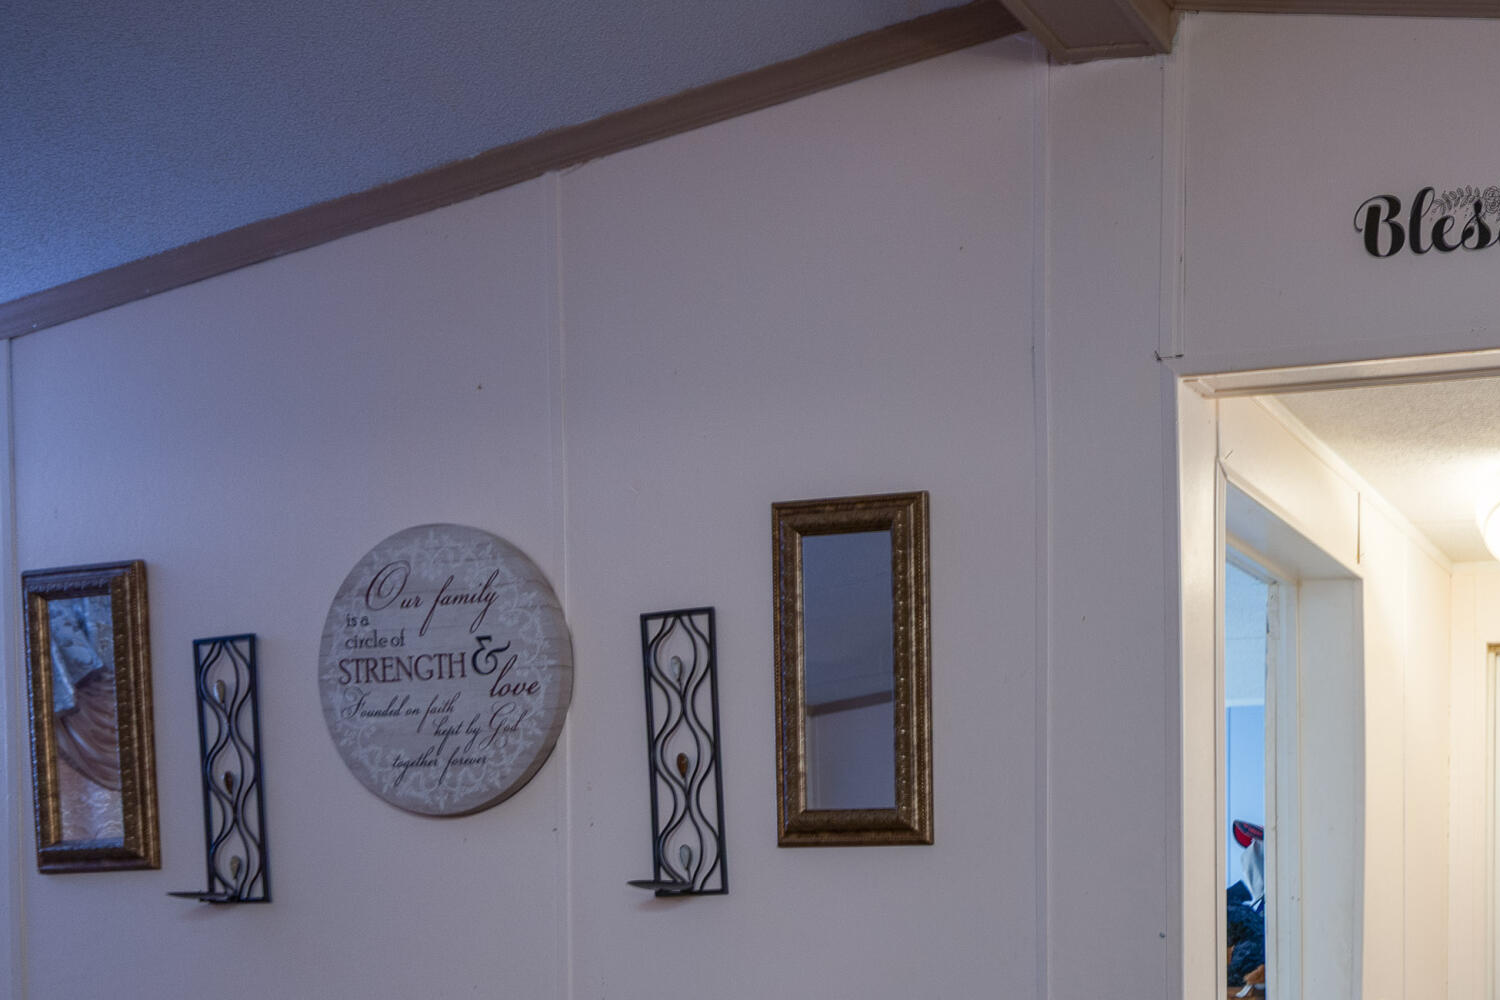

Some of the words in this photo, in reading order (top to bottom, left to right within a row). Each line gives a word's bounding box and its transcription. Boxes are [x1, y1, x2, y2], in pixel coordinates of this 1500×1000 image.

[365, 560, 422, 611] Our
[419, 569, 499, 635] family
[345, 629, 388, 649] circle
[391, 629, 406, 647] of
[346, 614, 358, 626] is
[360, 616, 370, 626] a
[338, 651, 467, 685] STRENGTH
[472, 636, 510, 675] &
[490, 655, 541, 697] love
[341, 687, 409, 719] Founded
[405, 705, 421, 716] on
[417, 692, 461, 733] faith
[434, 717, 462, 755] kept
[464, 713, 481, 753] by
[479, 703, 529, 749] God
[392, 746, 439, 785] together
[439, 747, 487, 784] forever
